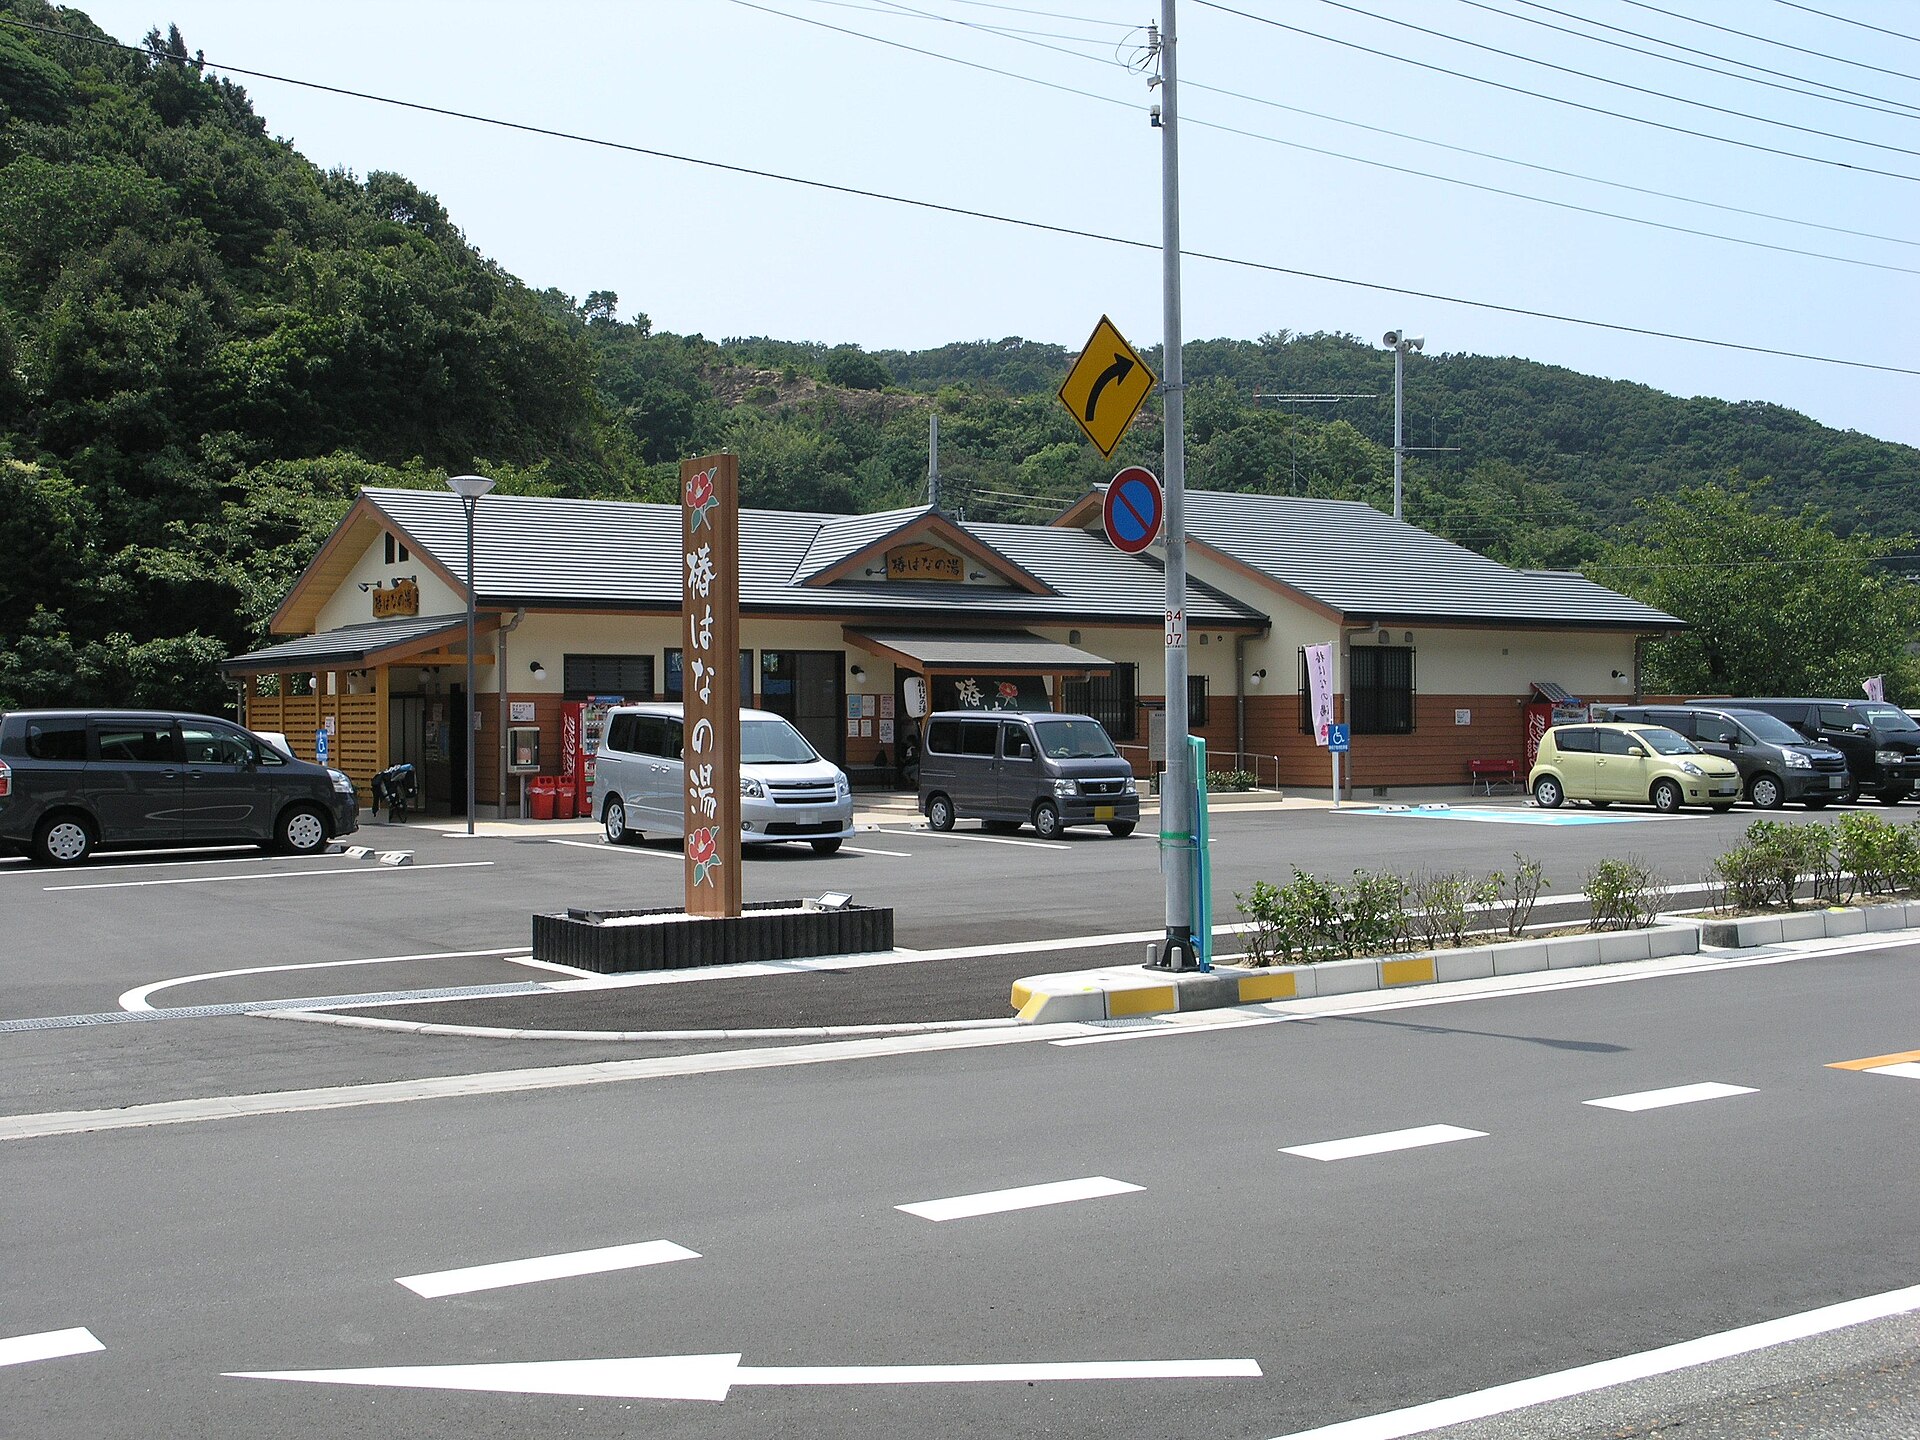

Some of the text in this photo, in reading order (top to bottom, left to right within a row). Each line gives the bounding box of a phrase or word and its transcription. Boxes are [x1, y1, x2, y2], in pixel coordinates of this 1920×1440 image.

[891, 556, 960, 576] 椿はなの湯
[1166, 610, 1182, 621] 64
[1166, 634, 1182, 645] 07
[686, 542, 717, 820] 椿はなの湯
[563, 712, 576, 777] ca-Cola
